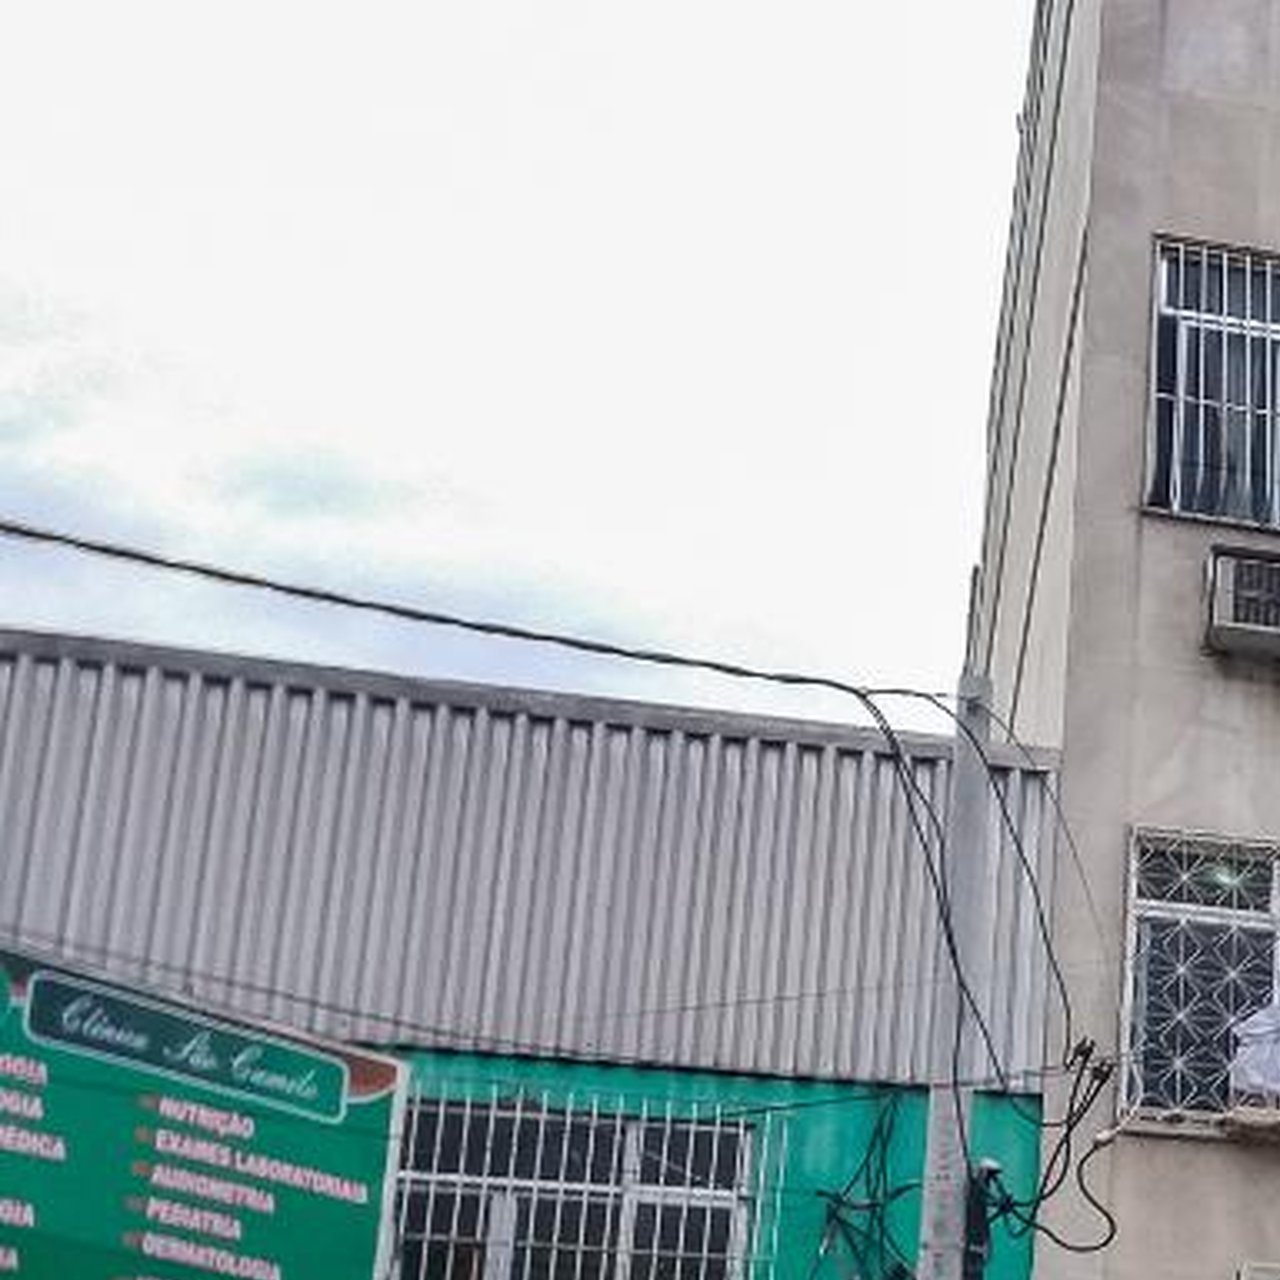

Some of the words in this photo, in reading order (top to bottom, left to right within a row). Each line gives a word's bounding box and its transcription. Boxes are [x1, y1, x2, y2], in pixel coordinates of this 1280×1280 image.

[158, 1097, 254, 1139] NUTRIÇÃO
[155, 1129, 231, 1166] EXAMES
[147, 1198, 241, 1240] PEDIATRIA
